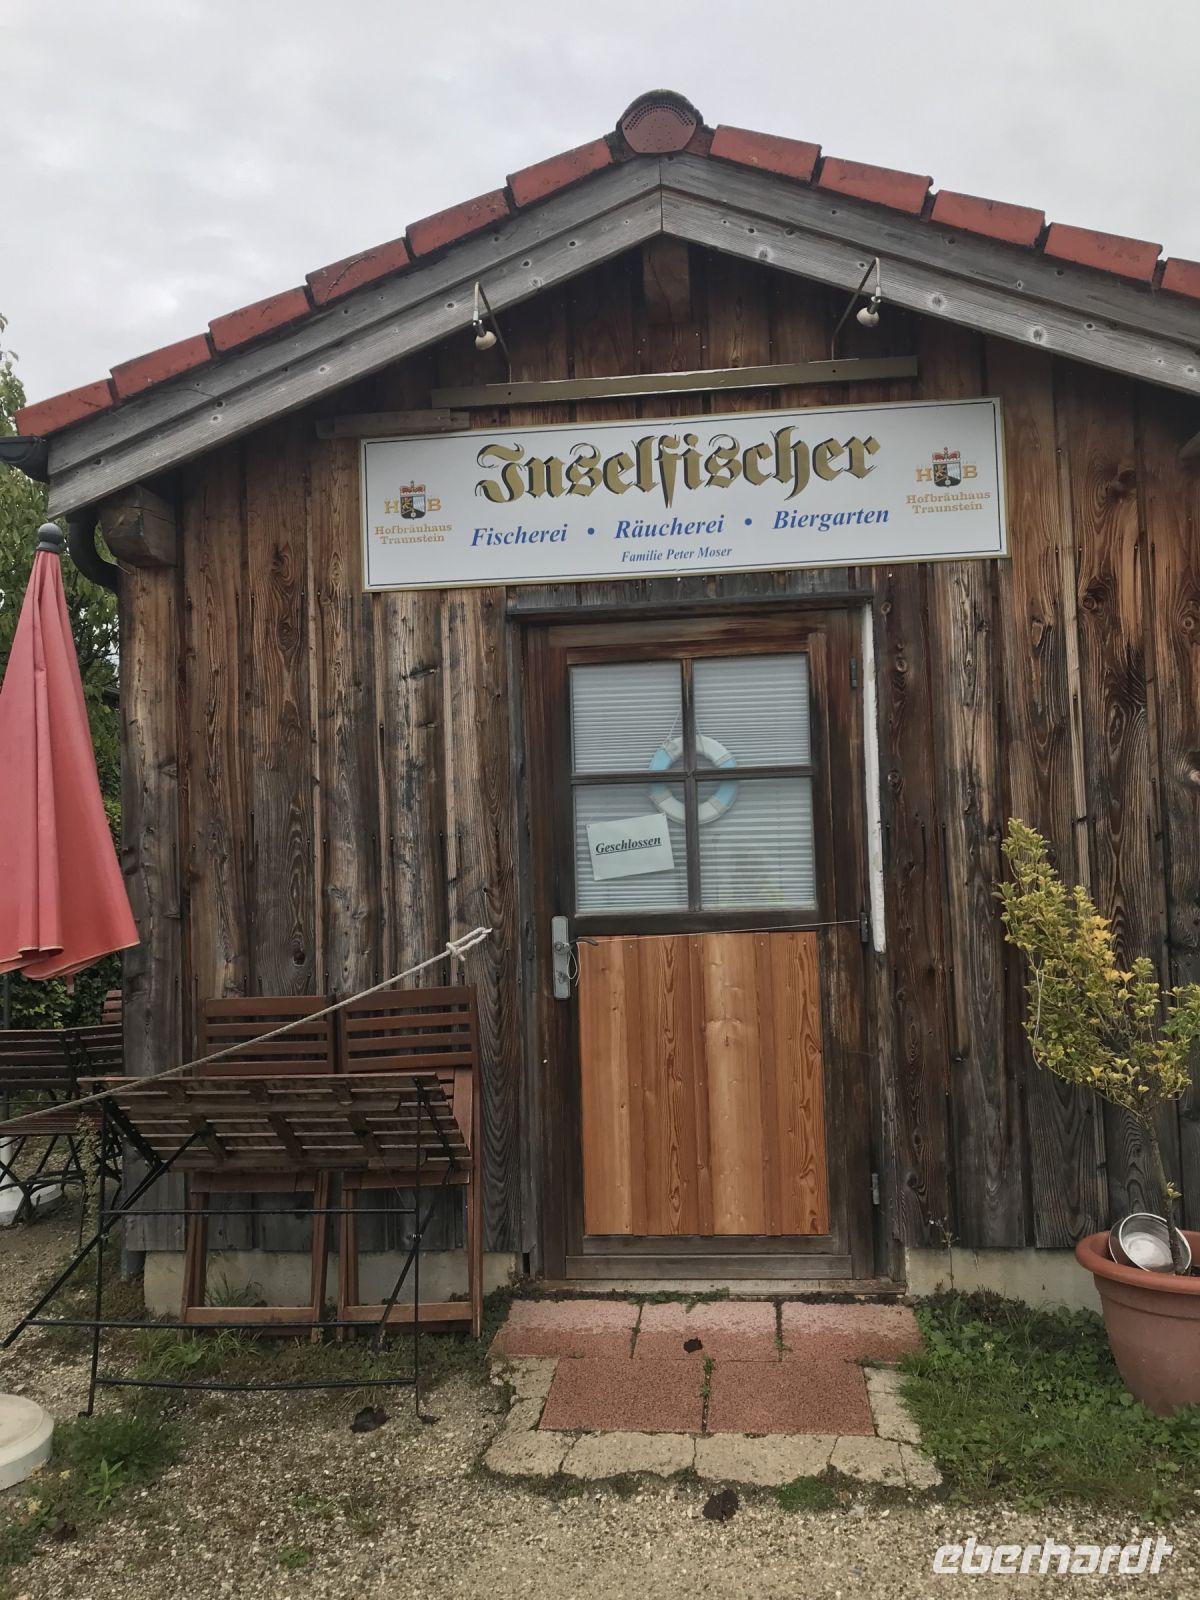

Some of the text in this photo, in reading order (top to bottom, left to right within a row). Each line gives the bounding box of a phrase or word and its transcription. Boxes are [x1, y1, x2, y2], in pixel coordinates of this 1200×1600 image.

[474, 425, 881, 509] Inselfischer
[915, 465, 977, 482] H B
[905, 491, 991, 504] Hofbräuhaus
[384, 498, 441, 514] H B
[912, 502, 983, 514] Traunstein
[374, 524, 452, 535] Hofbräuhaus
[470, 507, 890, 547] Fischerei Räucherei Biergarten
[380, 534, 445, 545] Traunstein
[621, 546, 733, 562] Familie Peter Moser
[595, 836, 662, 855] Geschlossen
